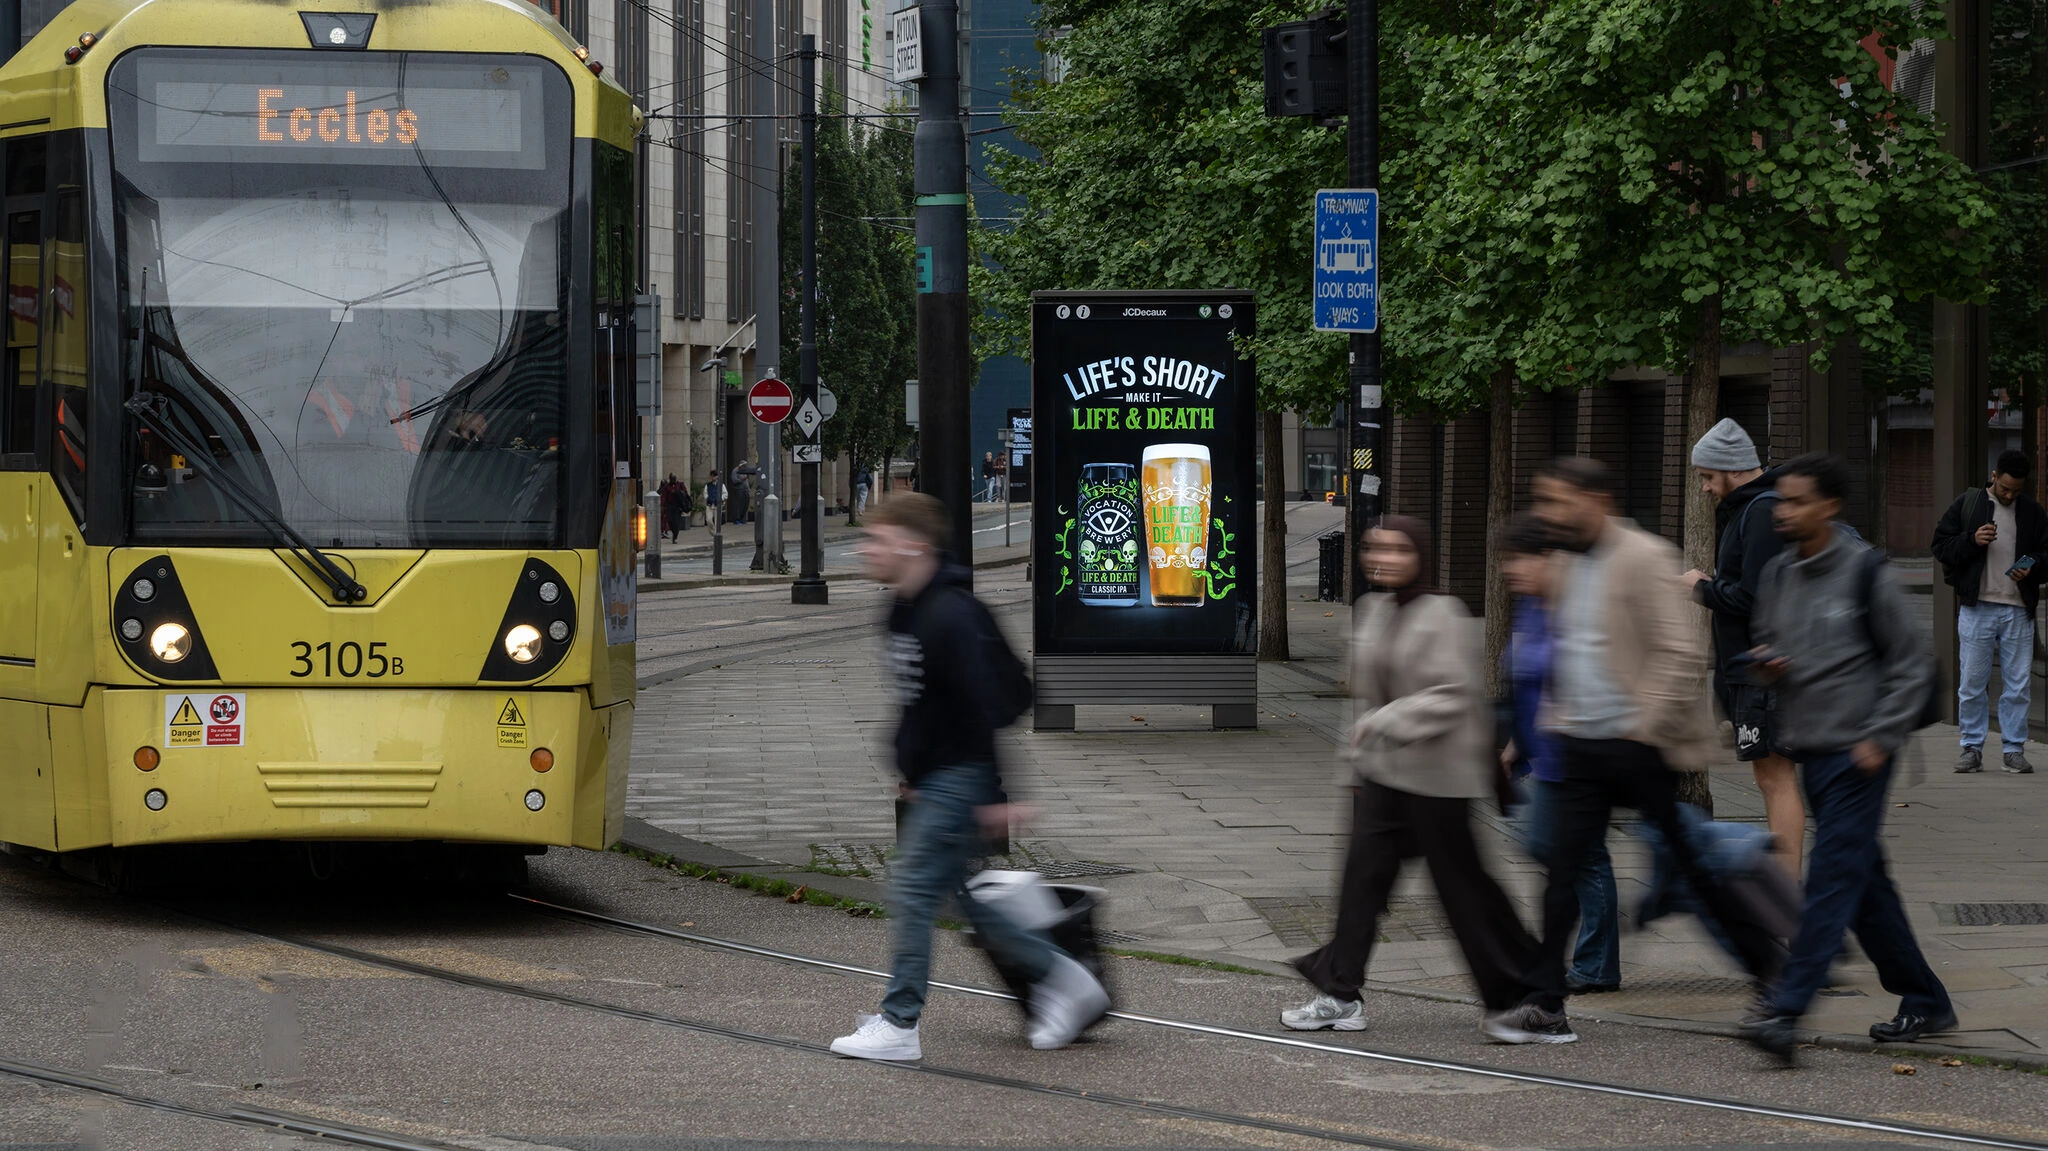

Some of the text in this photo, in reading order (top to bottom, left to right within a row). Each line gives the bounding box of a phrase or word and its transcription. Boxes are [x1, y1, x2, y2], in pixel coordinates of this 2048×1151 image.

[896, 14, 918, 44] AYTOUN
[896, 43, 918, 74] STREET
[258, 88, 418, 144] Eccles
[1323, 198, 1370, 214] TRAMWAY
[1317, 281, 1374, 299] LOOK BOTH
[1122, 308, 1167, 317] JCDecaux
[1331, 306, 1359, 324] WAYS
[1062, 355, 1226, 401] LIFE'S SHORT
[1125, 392, 1161, 403] MAKE IT
[803, 410, 813, 424] 5
[1072, 407, 1215, 430] LIFE & DEATH
[1084, 500, 1133, 518] VOCATION
[1085, 527, 1132, 544] BREWERY
[1152, 525, 1203, 544] DEATH
[1081, 572, 1138, 583] LIFE & DEATH
[1091, 585, 1128, 594] CLASSIC IPA
[171, 729, 201, 738] Danger
[501, 730, 523, 739] Danger
